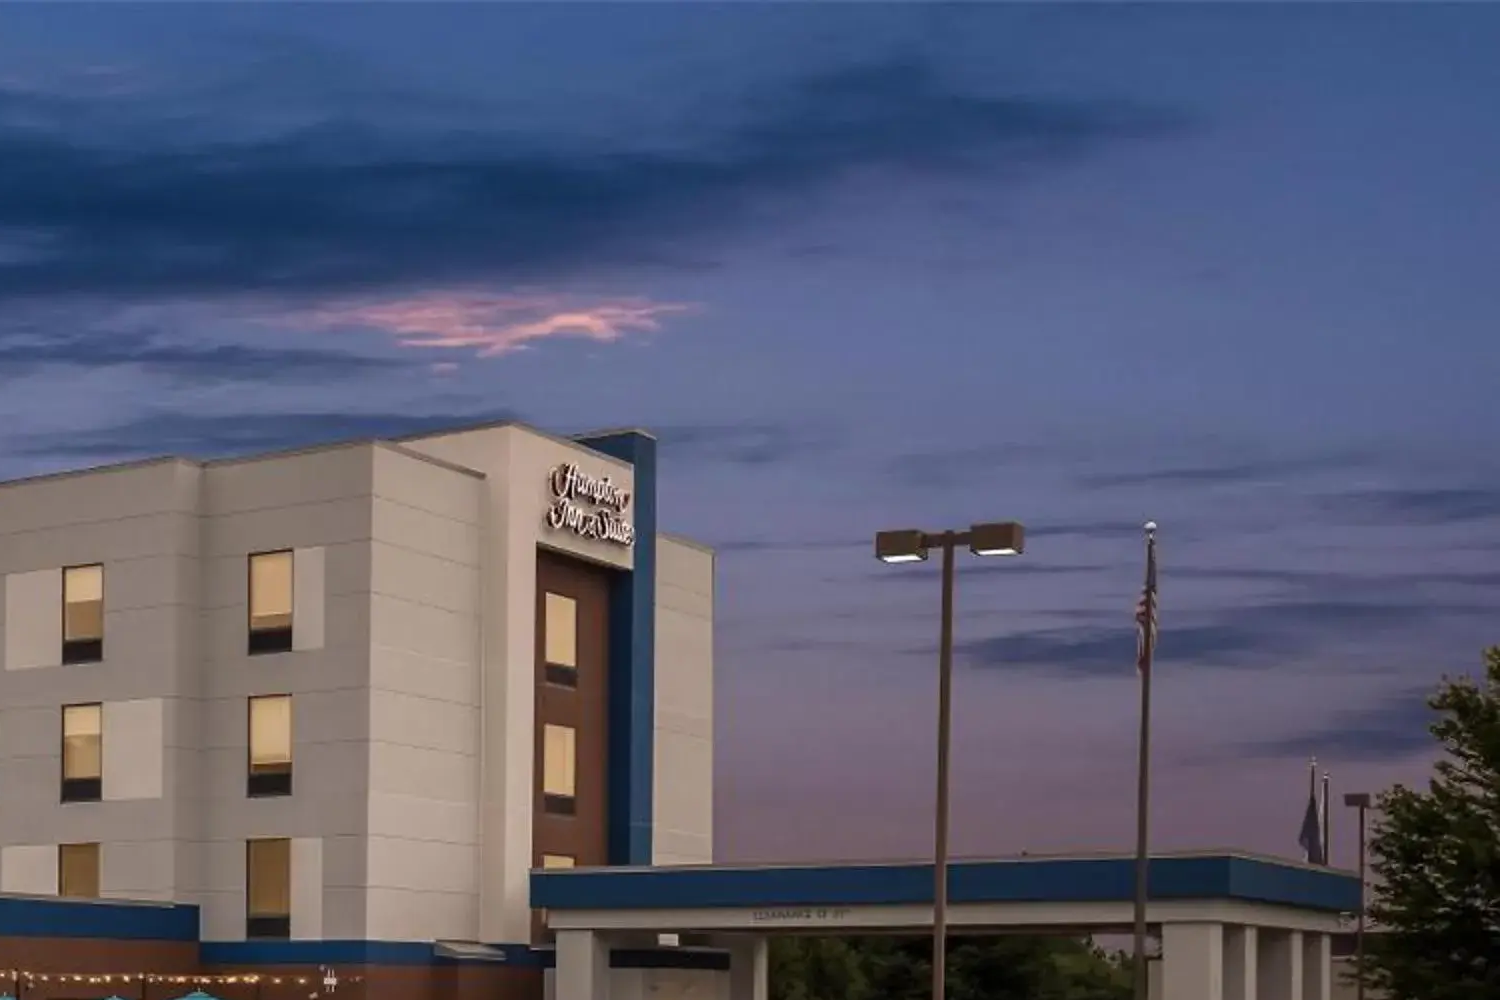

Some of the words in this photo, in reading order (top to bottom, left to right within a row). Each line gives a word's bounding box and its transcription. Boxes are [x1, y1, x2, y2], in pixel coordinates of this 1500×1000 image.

[549, 463, 630, 513] Hampton
[549, 498, 587, 534] Inn
[597, 508, 634, 544] Suites
